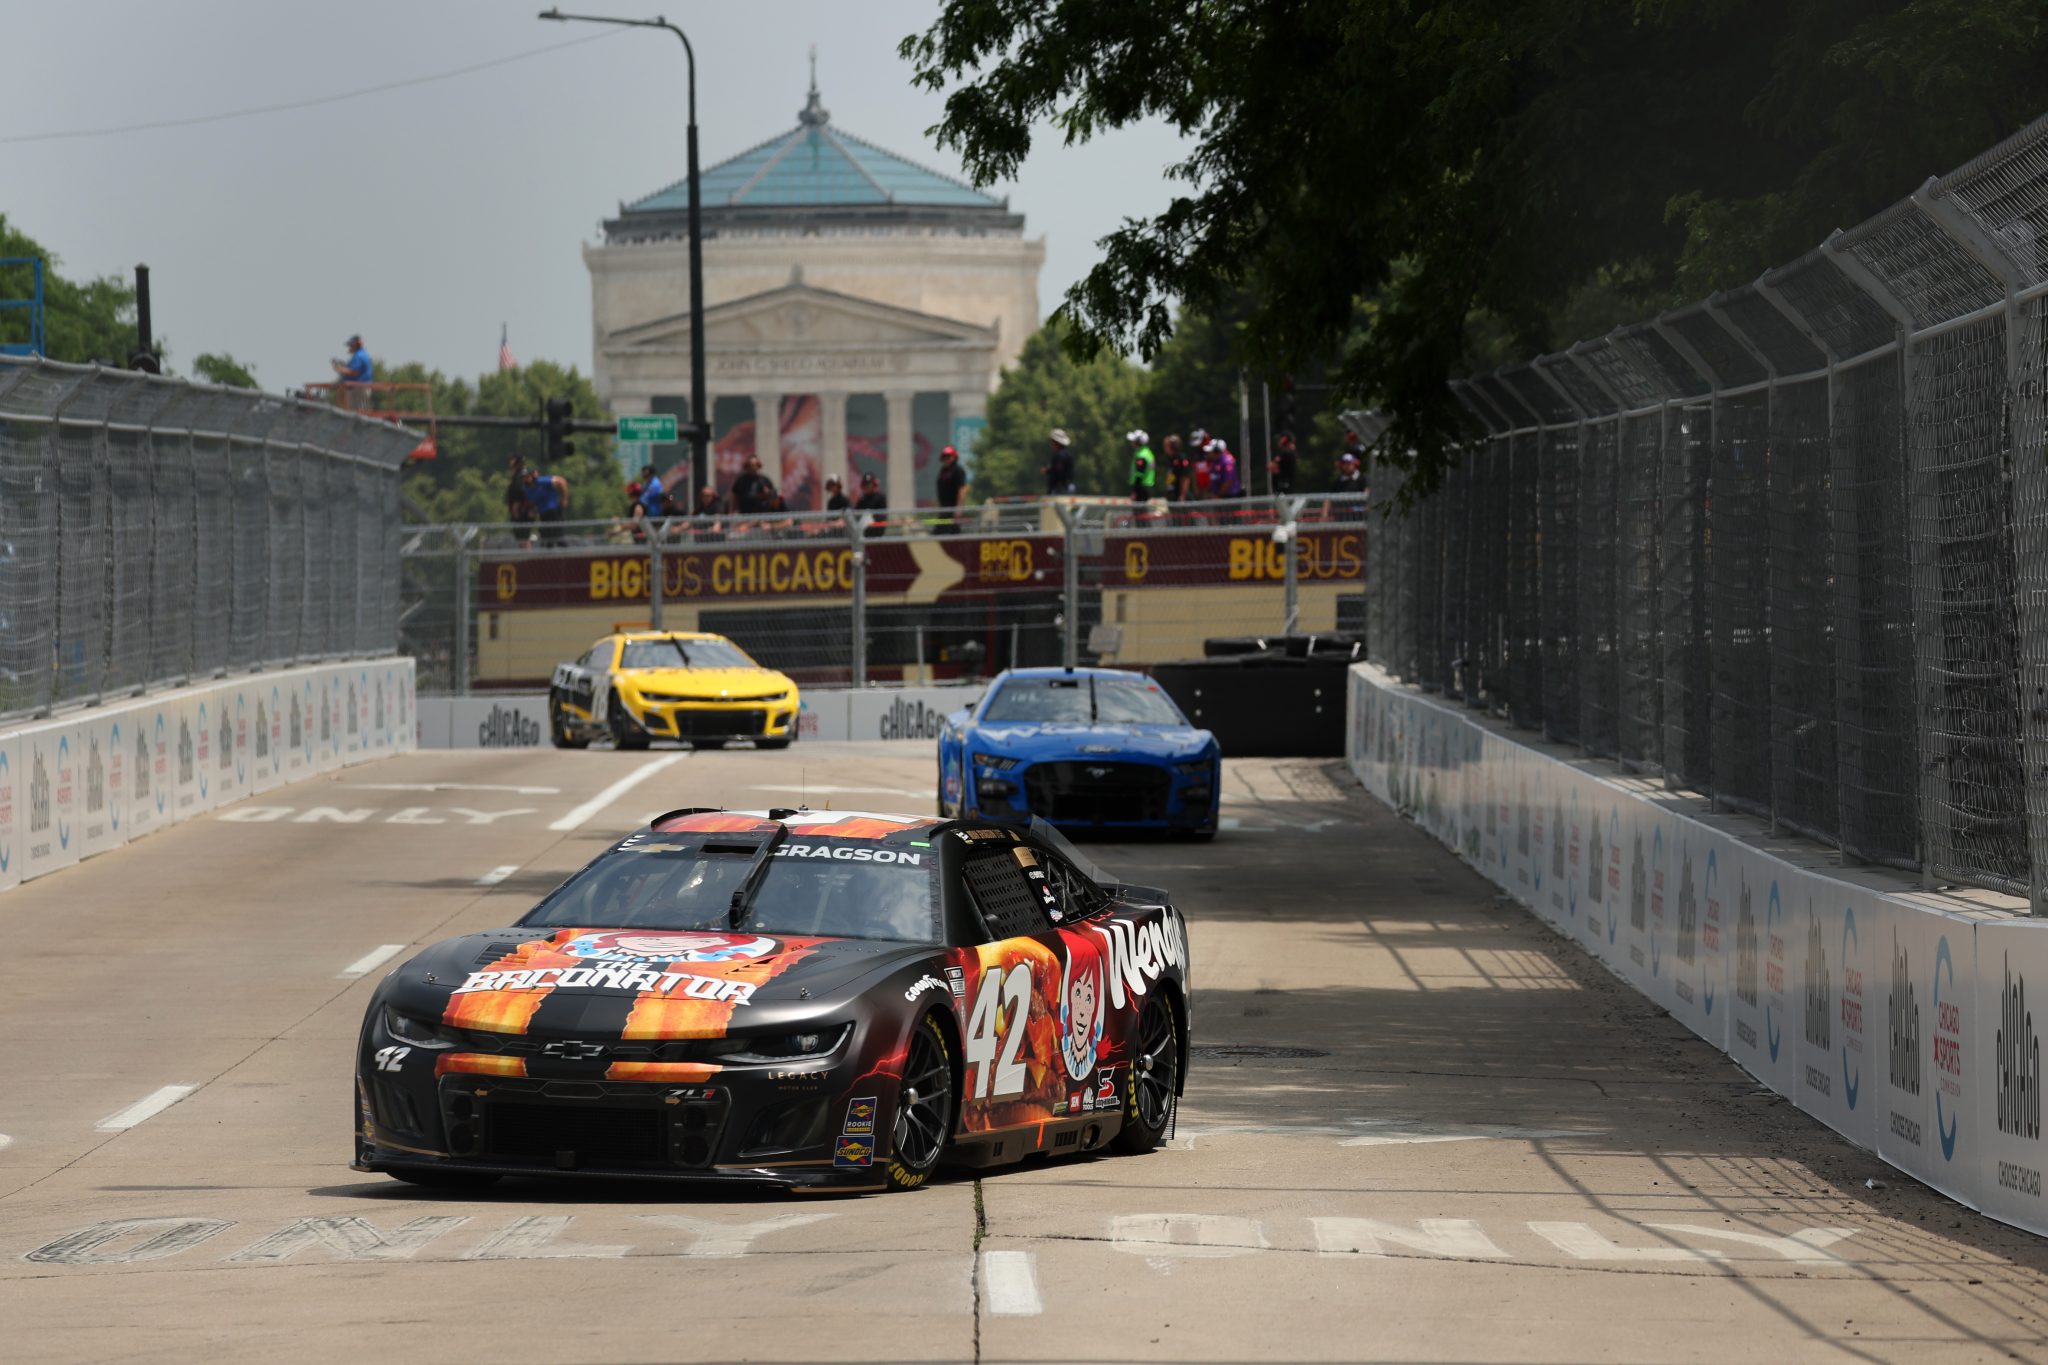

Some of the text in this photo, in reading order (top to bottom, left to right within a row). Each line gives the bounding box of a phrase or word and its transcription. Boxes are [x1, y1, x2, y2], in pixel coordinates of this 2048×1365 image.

[712, 550, 855, 595] CHICAGO
[479, 704, 540, 748] CHICAGO
[216, 806, 540, 824] ONLY
[772, 844, 921, 865] GRAGSON
[595, 961, 651, 972] THE
[451, 967, 759, 1007] BACONATOR
[904, 974, 950, 1002] GOODYEAR
[1889, 923, 1920, 1096] CHICAGO
[1938, 1001, 1959, 1035] CHICAGO
[966, 963, 1032, 1099] 42
[1997, 948, 2039, 1140] CHICAGO
[375, 1045, 411, 1072] 42
[768, 1071, 828, 1081] LEGACY
[1939, 1041, 1960, 1076] SPORTS
[1890, 1110, 1920, 1147] CHOOSE CHICAGO
[837, 1147, 871, 1156] SUNOCO
[1999, 1160, 2040, 1198] CHOOSE CHICAGO
[24, 1212, 841, 1264] ONLY
[1109, 1213, 1862, 1265] ONLY
